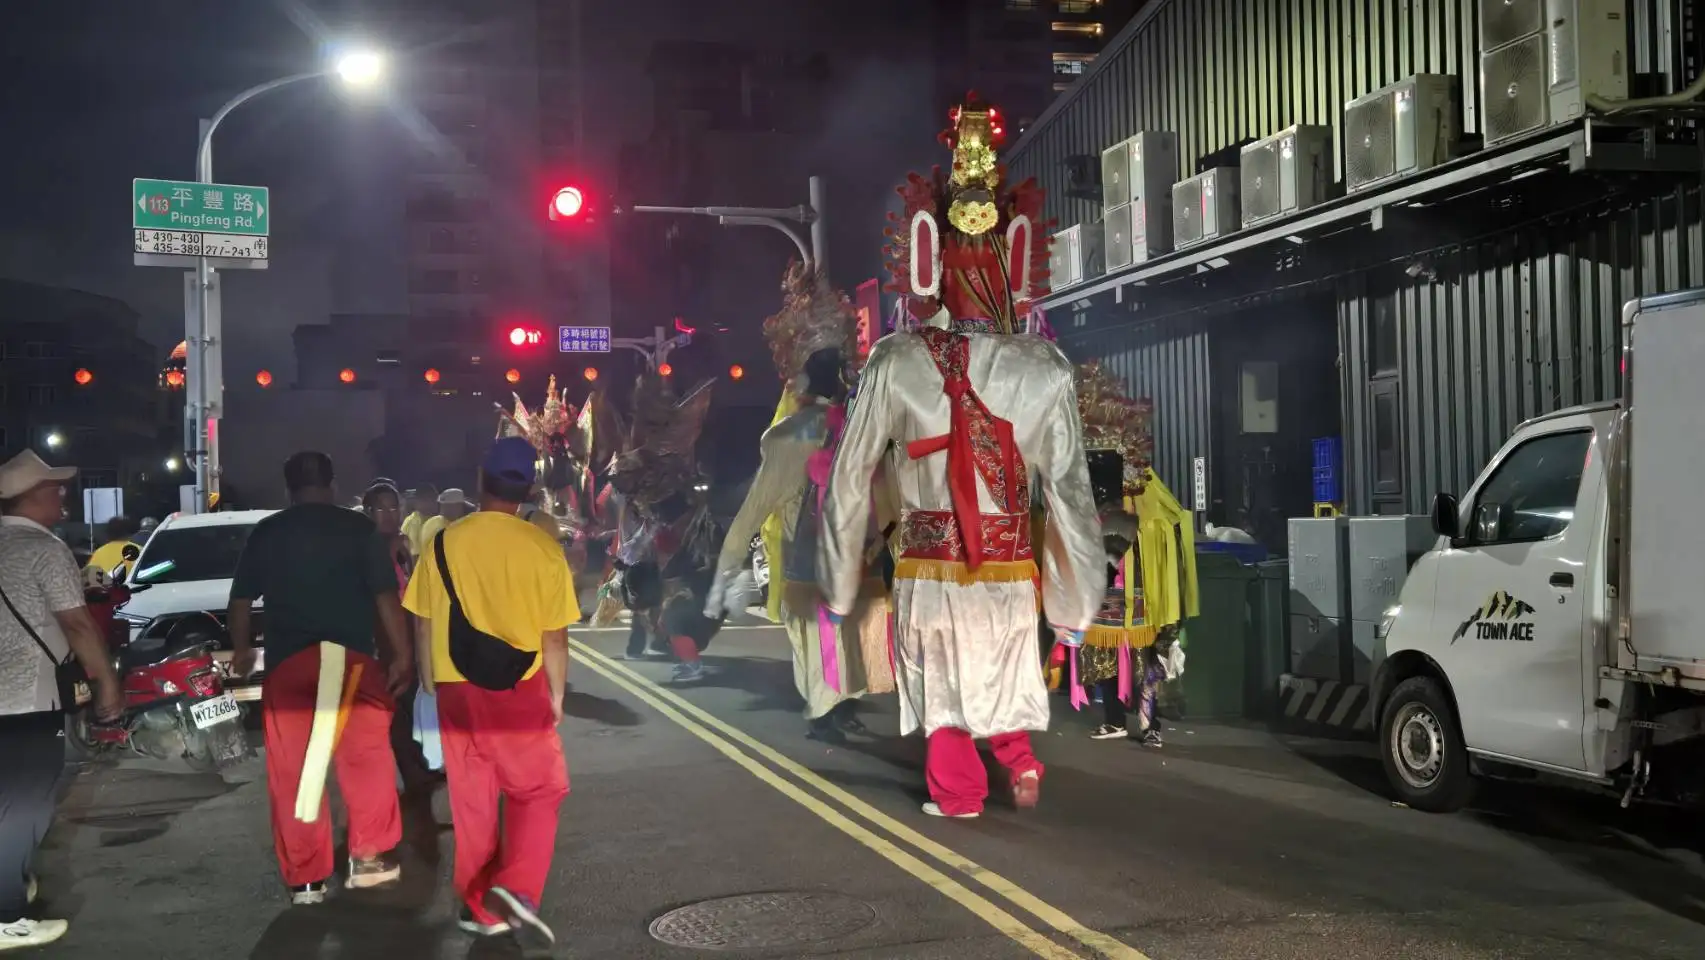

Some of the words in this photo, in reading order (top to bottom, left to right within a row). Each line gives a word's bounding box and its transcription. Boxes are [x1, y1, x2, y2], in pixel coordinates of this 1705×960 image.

[150, 196, 169, 212] 113
[171, 187, 254, 212] 平豐路
[171, 211, 231, 229] Pingfeng
[135, 229, 150, 243] 北
[153, 231, 200, 244] 430-430
[153, 243, 200, 255] 435-389
[254, 238, 266, 250] 南
[1476, 622, 1508, 640] TOWN
[1509, 622, 1534, 641] ACE
